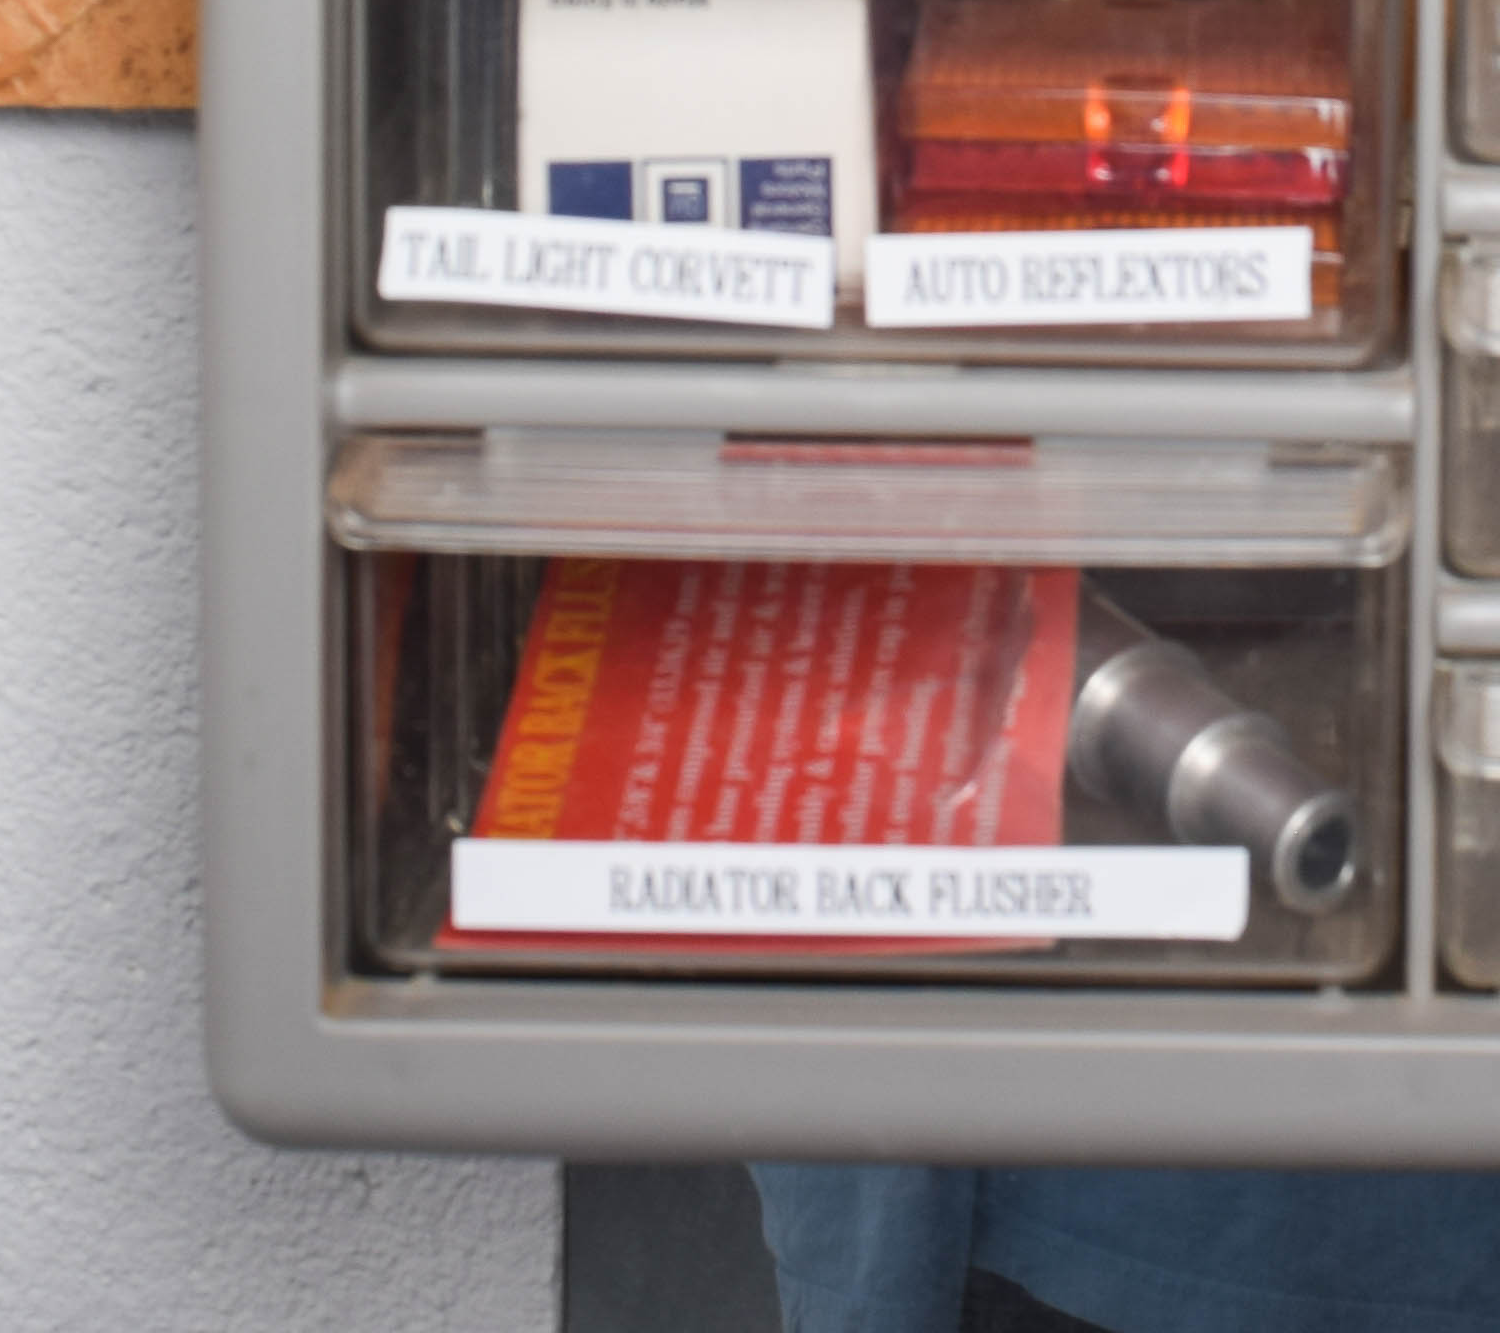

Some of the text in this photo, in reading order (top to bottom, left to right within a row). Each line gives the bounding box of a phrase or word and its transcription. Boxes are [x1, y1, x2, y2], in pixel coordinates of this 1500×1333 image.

[401, 228, 815, 309] TAIL LIGHT CORVETT
[903, 249, 1269, 303] AUTO REFLEXTORS
[516, 647, 600, 734] BACK
[607, 869, 1094, 921] RADIATOR BACK FLUSHER
